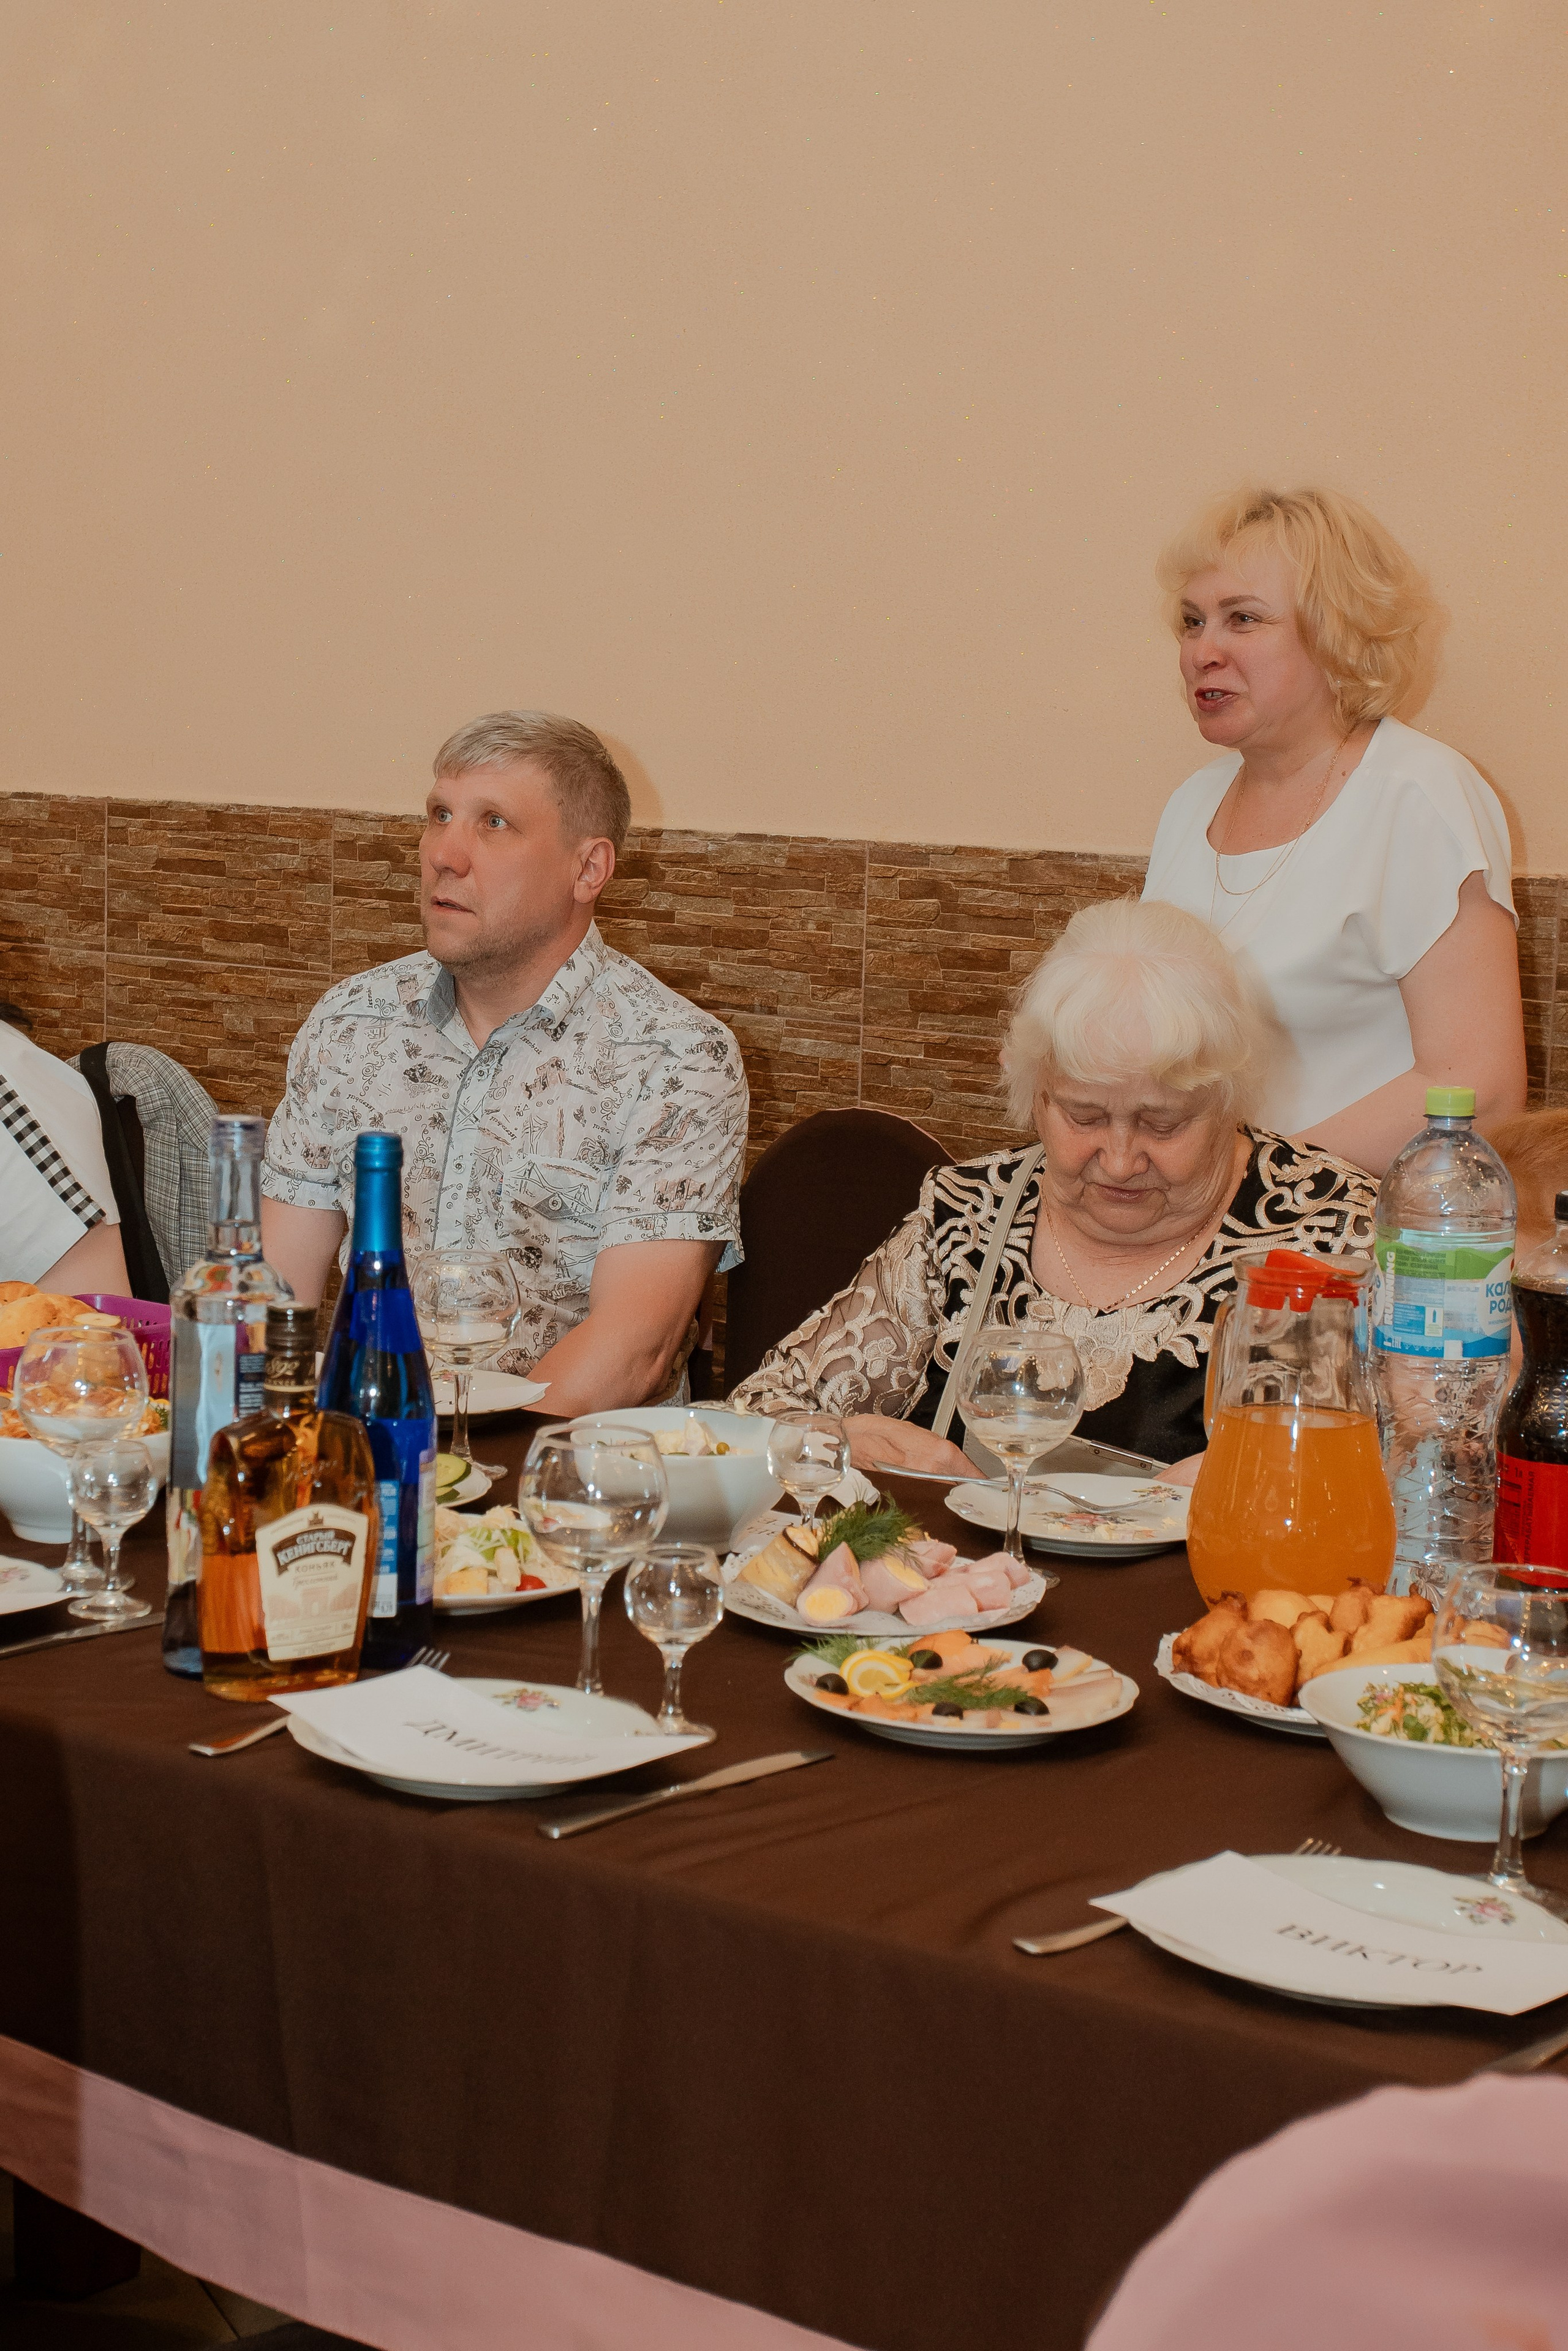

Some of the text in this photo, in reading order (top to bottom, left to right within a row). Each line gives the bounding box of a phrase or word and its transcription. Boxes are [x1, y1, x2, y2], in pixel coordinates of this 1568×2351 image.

[1384, 1251, 1396, 1326] RUNNING
[277, 1540, 353, 1566] КЕНИГСБЕРГ
[295, 1561, 335, 1574] КОНЬЯК
[1274, 1922, 1483, 1975] ВИКТОР
